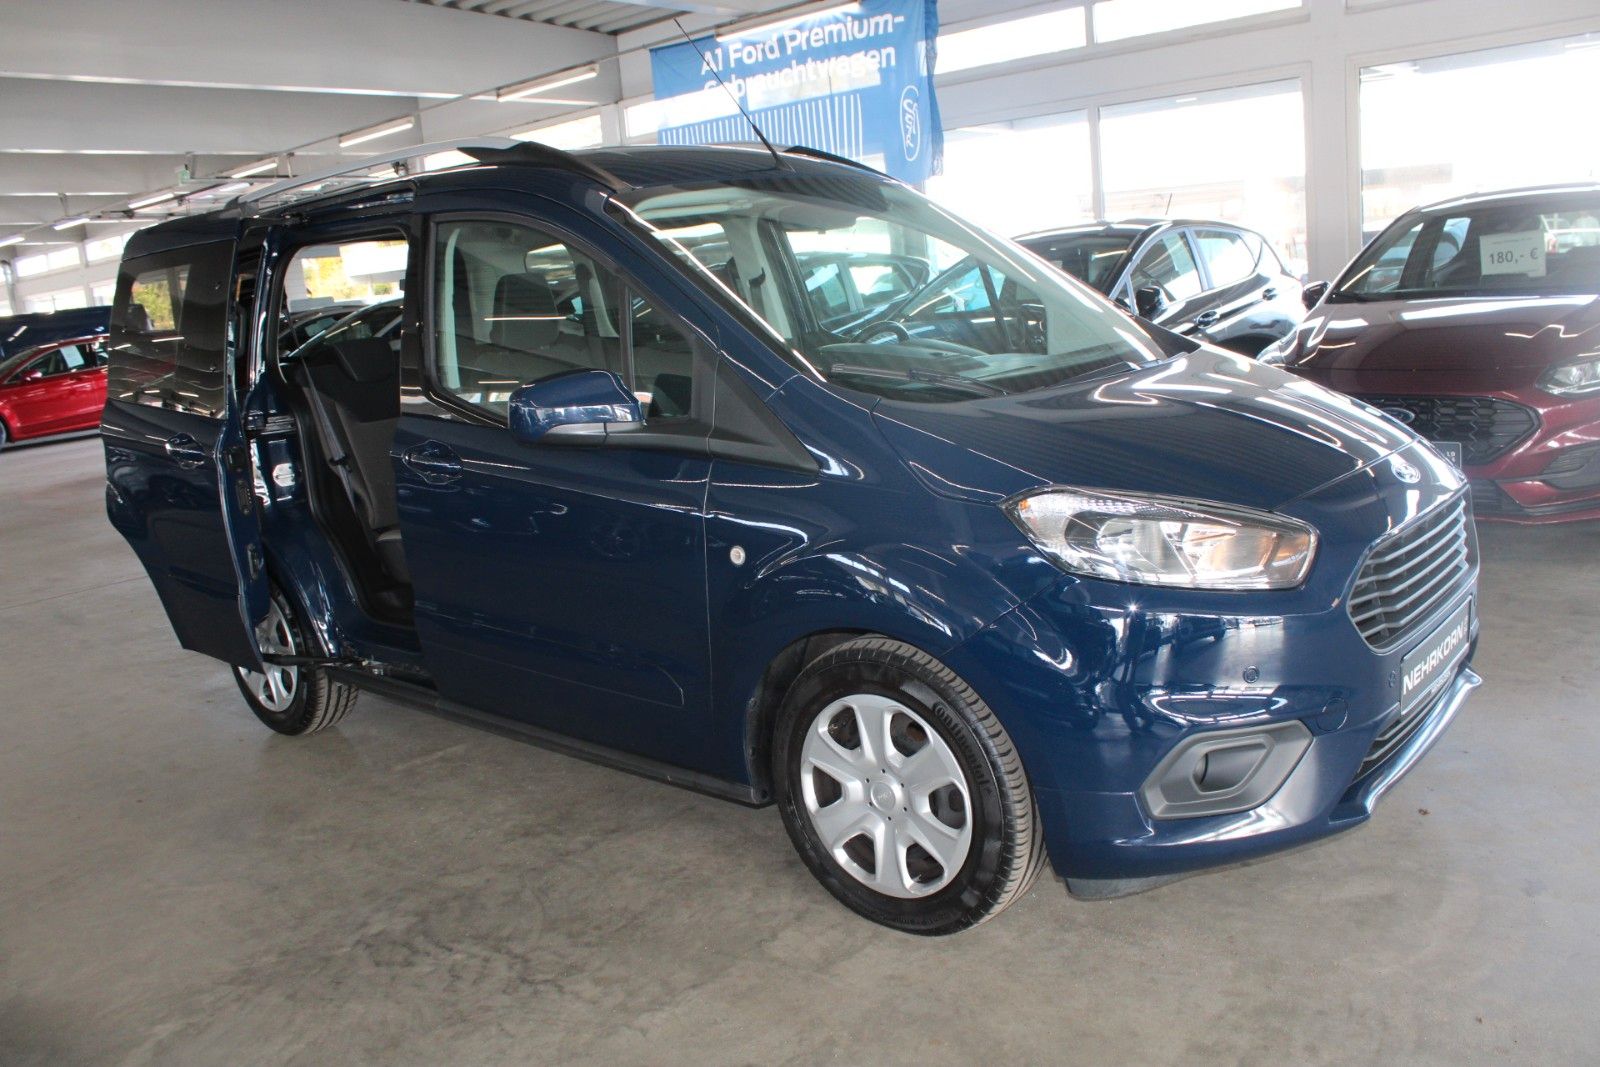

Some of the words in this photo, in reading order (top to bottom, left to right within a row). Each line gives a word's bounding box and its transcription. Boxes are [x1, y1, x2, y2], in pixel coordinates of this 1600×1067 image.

[729, 33, 780, 68] Ford
[784, 12, 905, 55] Premium-
[703, 45, 896, 99] buchtwagen
